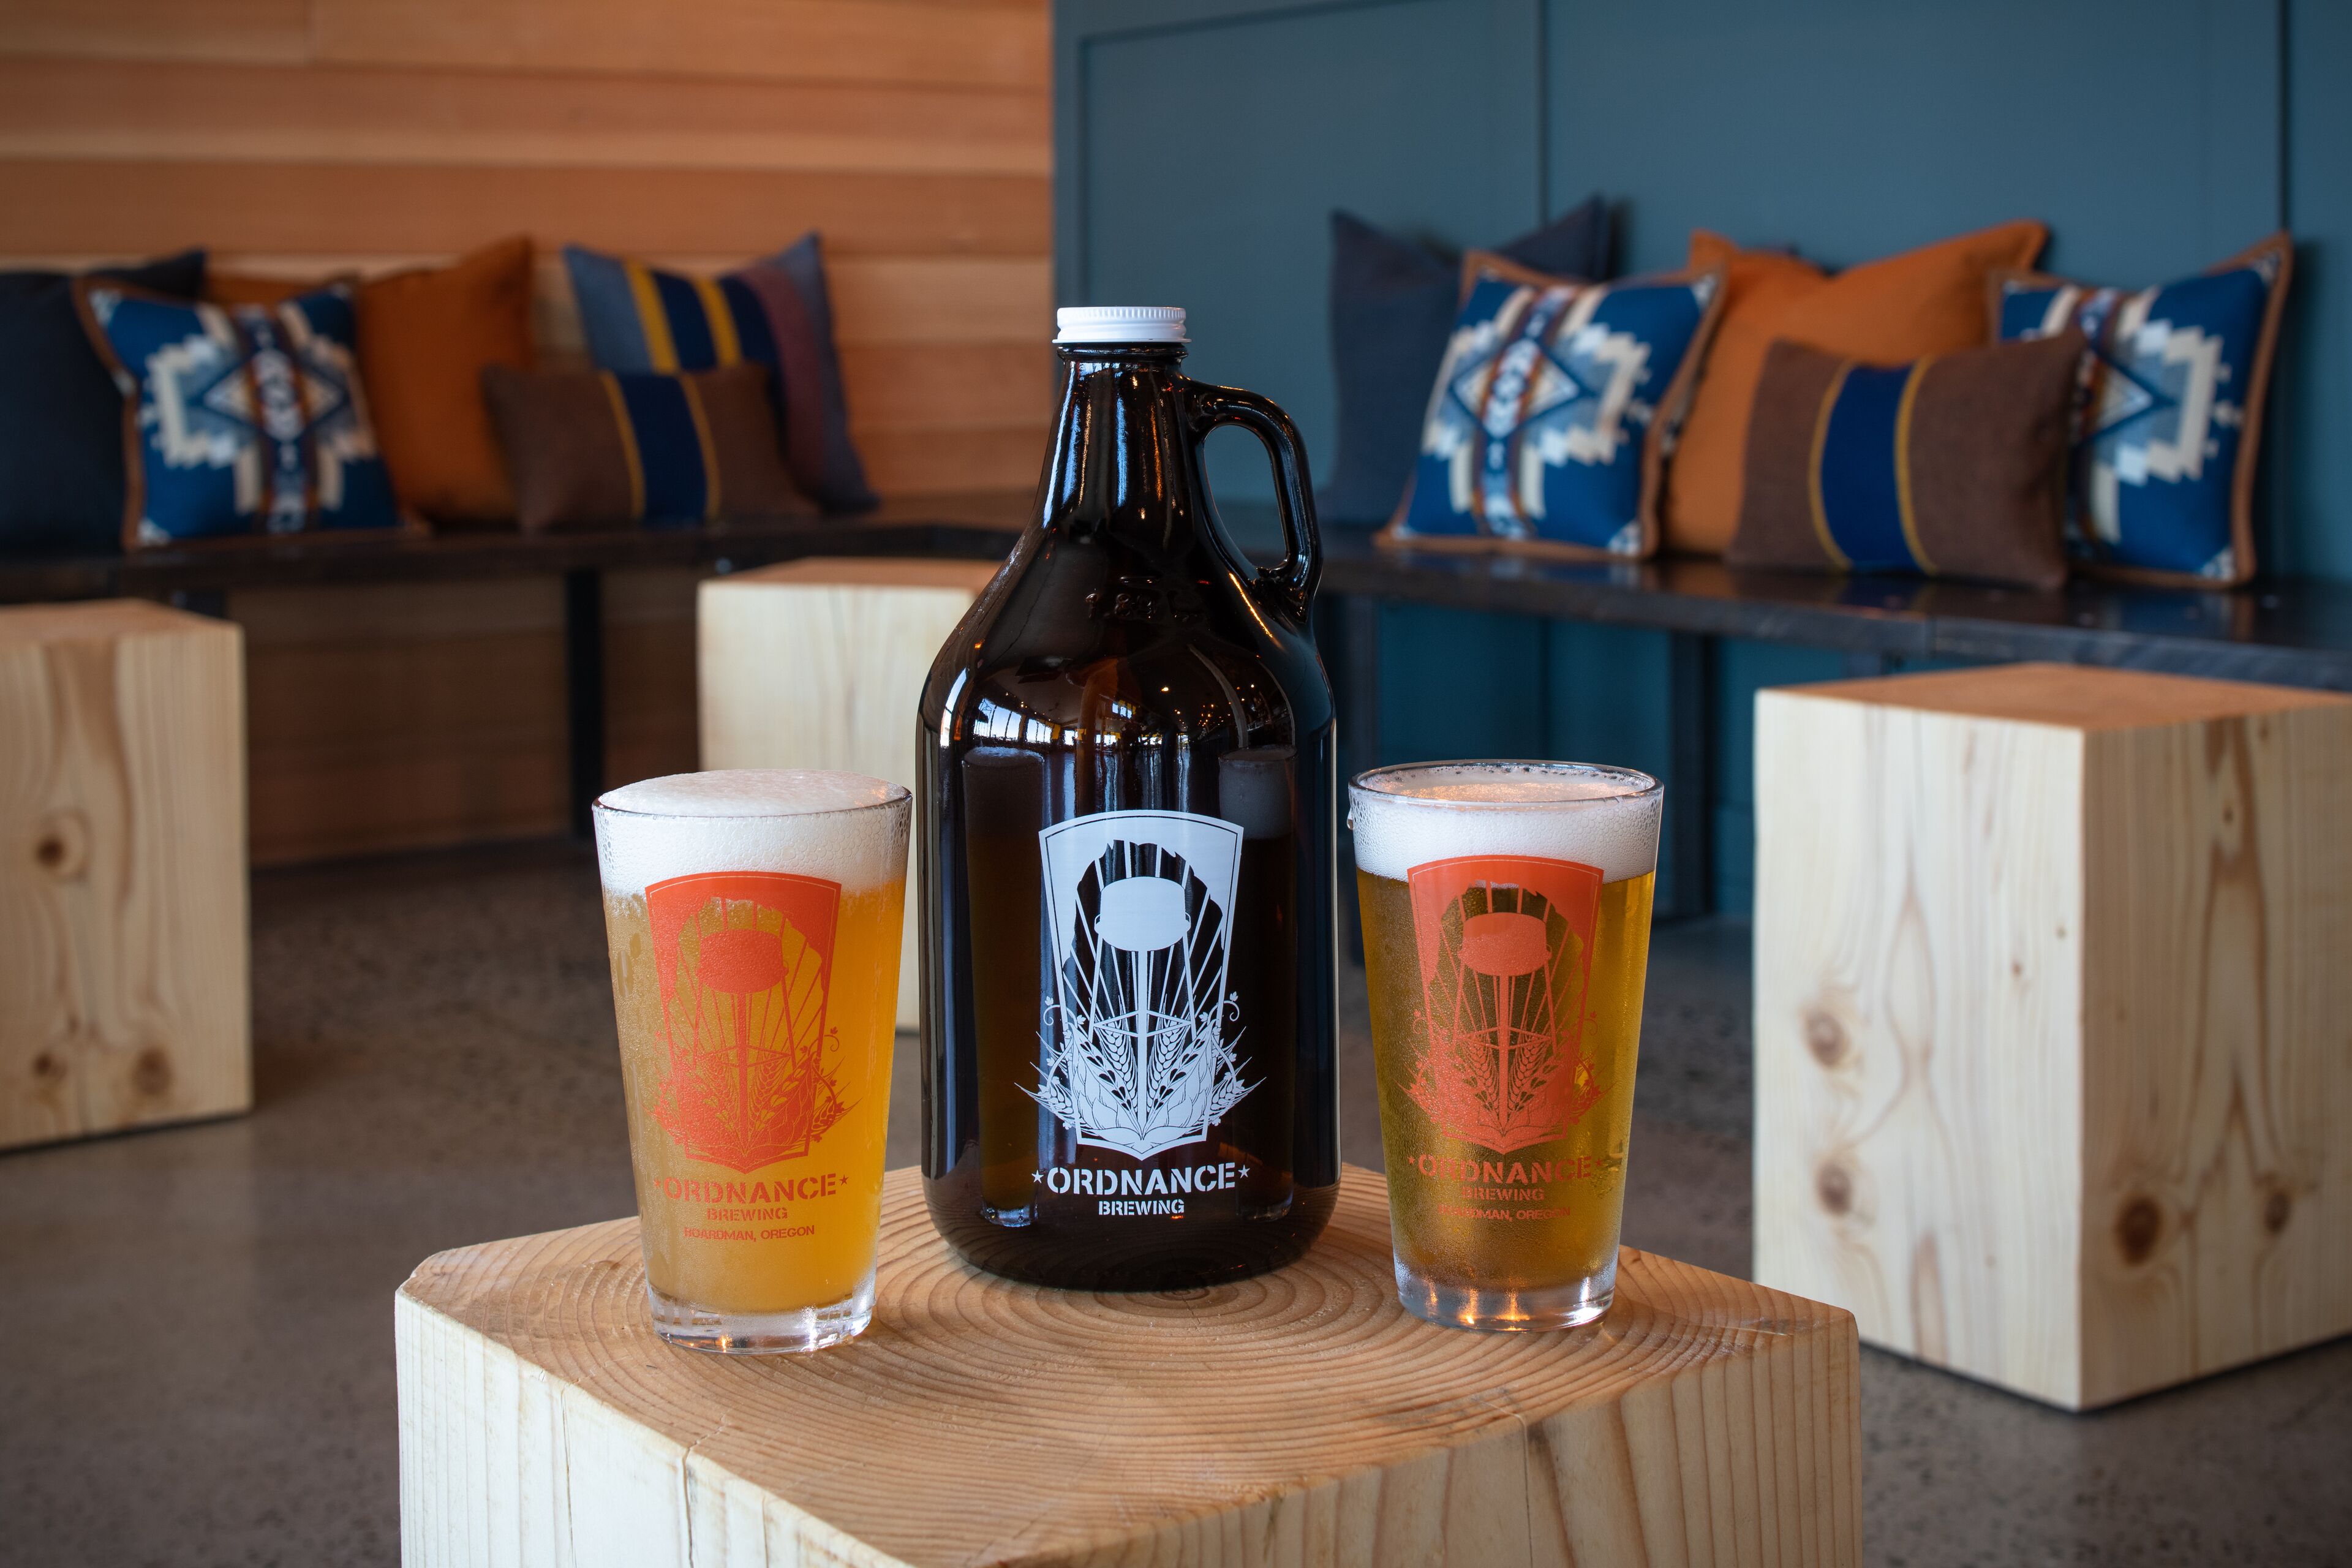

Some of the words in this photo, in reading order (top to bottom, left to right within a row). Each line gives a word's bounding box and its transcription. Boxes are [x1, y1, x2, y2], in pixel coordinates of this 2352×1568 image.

[1418, 1153, 1591, 1185] ORDNANCE
[1047, 1162, 1235, 1195] ORDNANCE
[663, 1173, 836, 1204] ORDNANCE
[1461, 1186, 1545, 1201] BREWING
[707, 1207, 788, 1221] BREWING
[1099, 1199, 1185, 1216] BREWING
[760, 1225, 815, 1239] OREGON
